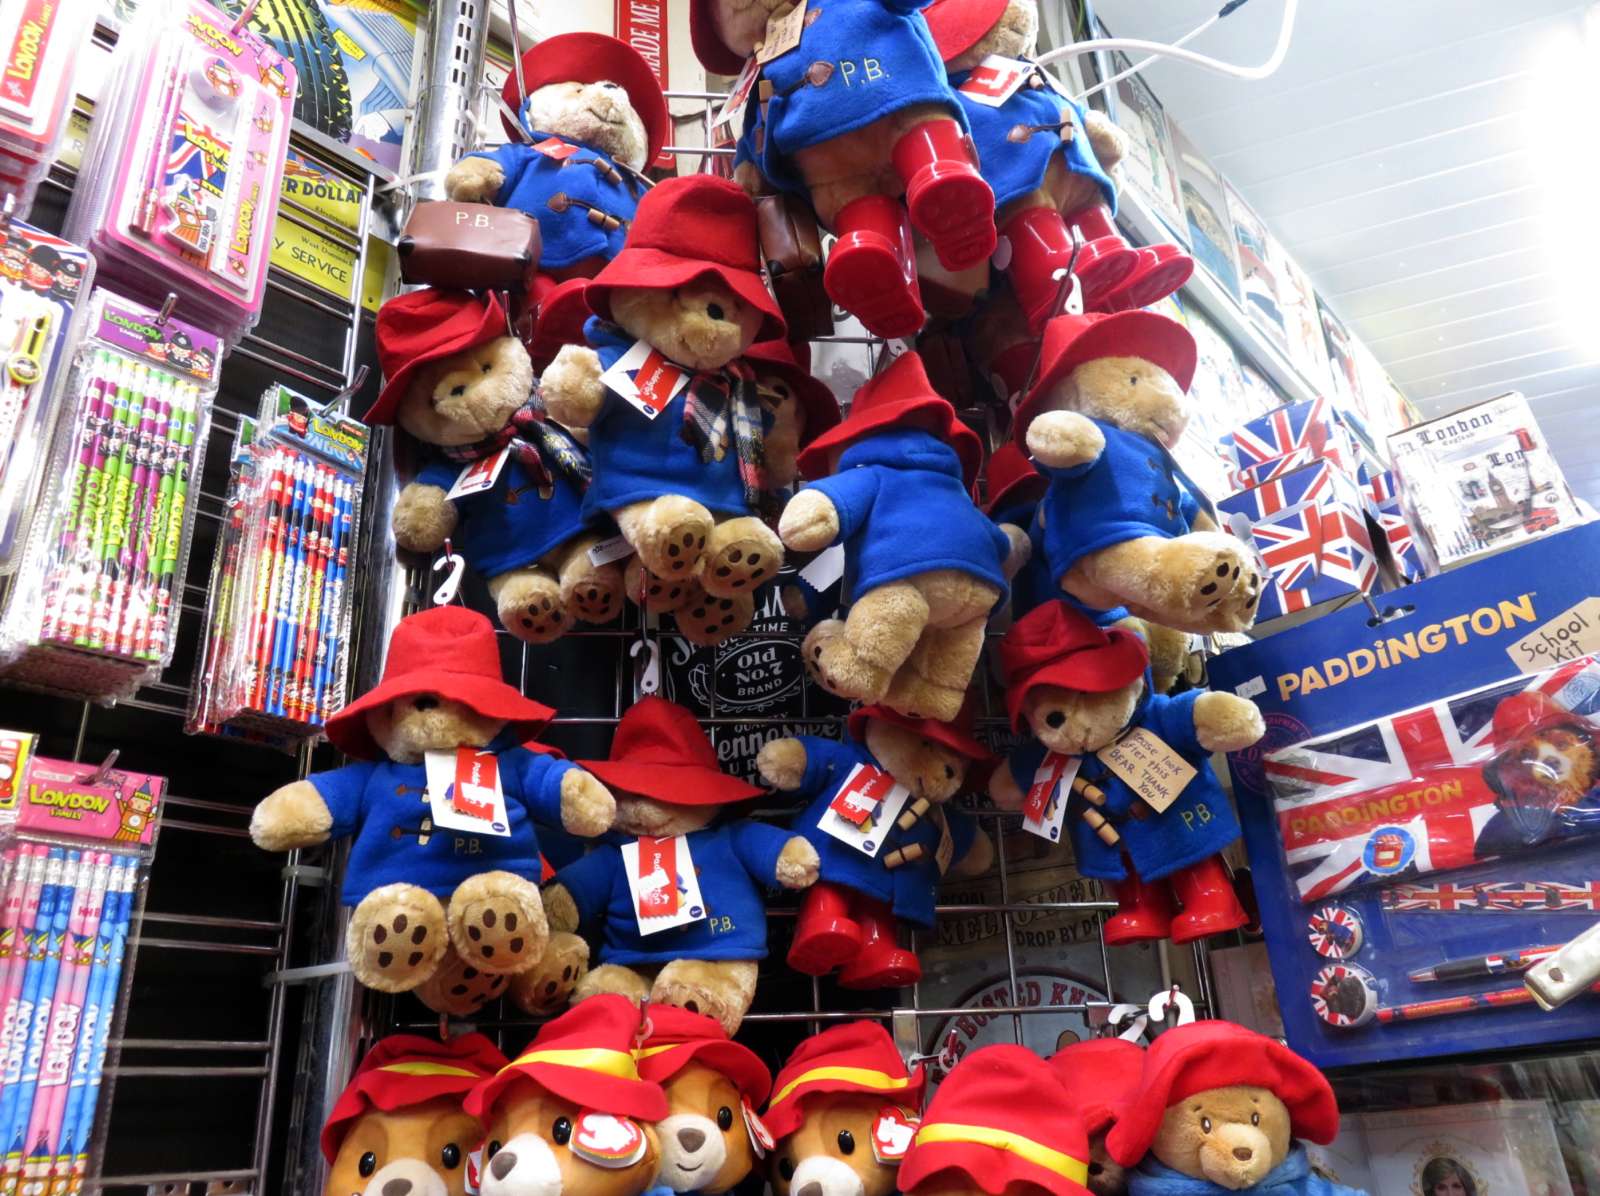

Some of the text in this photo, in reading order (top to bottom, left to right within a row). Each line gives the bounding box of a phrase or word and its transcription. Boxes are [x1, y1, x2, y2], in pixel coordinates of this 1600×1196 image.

[6, 20, 44, 80] LONDON
[838, 58, 890, 88] P.B.
[230, 199, 254, 256] LONDON
[455, 211, 494, 231] P.B.
[290, 246, 348, 284] SERVICE
[102, 309, 164, 342] LONDON
[312, 417, 365, 454] LONDON
[1416, 412, 1493, 445] London
[1520, 612, 1590, 662] School
[1549, 640, 1584, 663] Kit
[737, 647, 777, 669] Old
[769, 661, 784, 676] 7
[737, 678, 784, 696] BRAND
[1109, 748, 1170, 799] BEAR THANK
[1120, 742, 1170, 780] after this
[1162, 755, 1184, 776] look
[29, 784, 111, 814] LONDON
[1180, 803, 1217, 832] P.B.
[453, 838, 482, 855] P.B.
[709, 916, 736, 936] P.B.
[1014, 926, 1056, 947] DROP
[1058, 920, 1080, 945] BY
[955, 981, 1041, 1040] BUSTED
